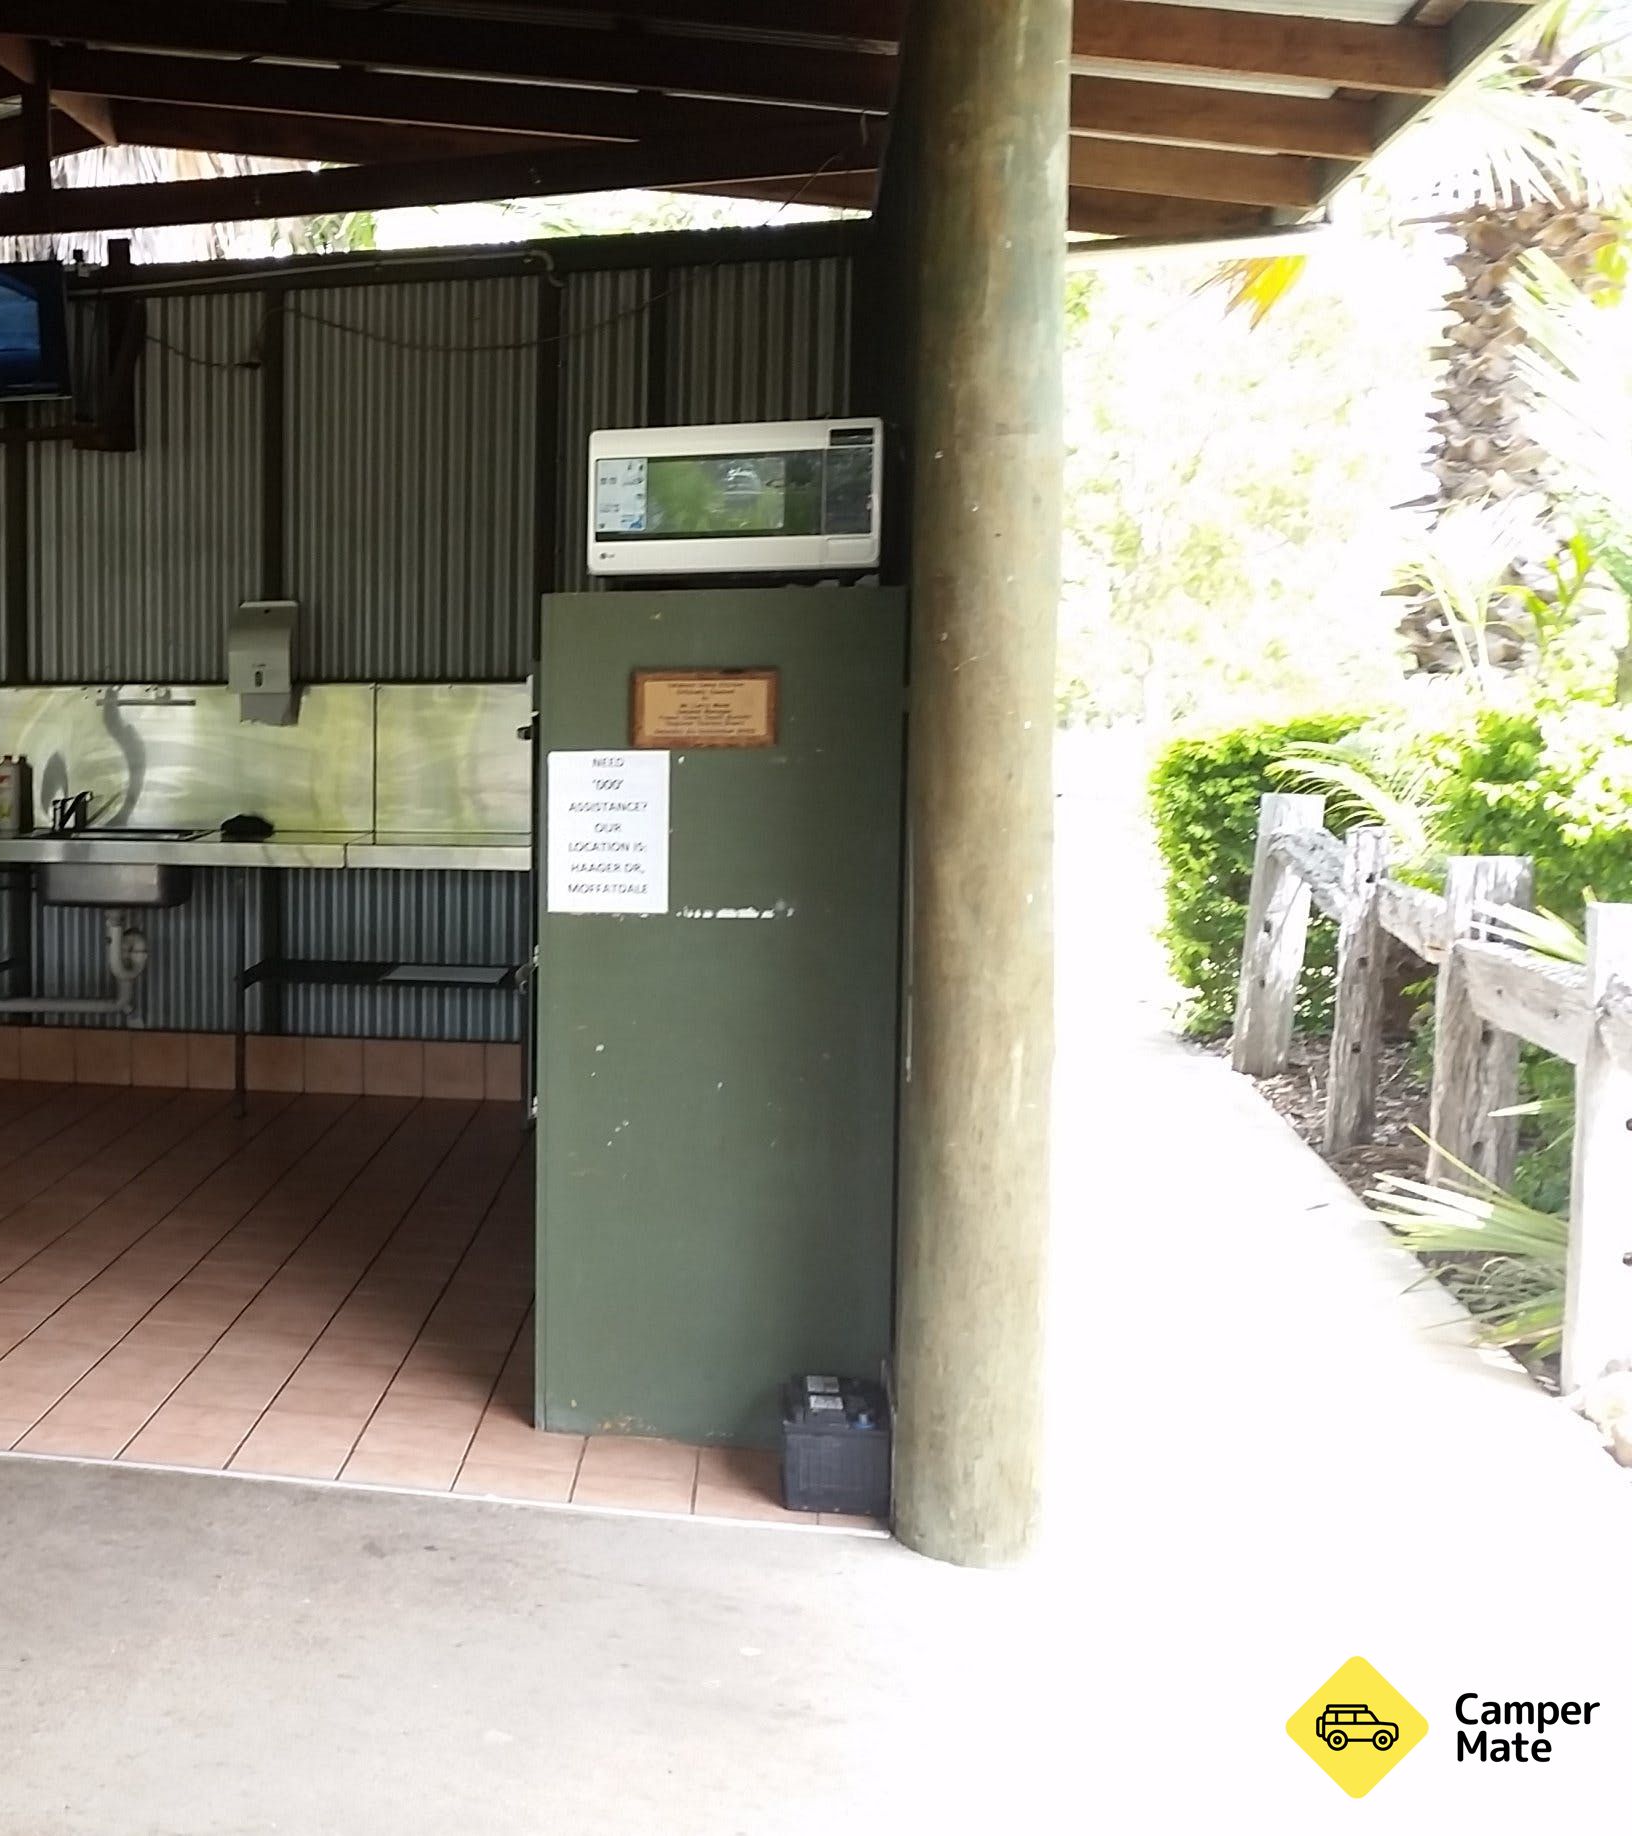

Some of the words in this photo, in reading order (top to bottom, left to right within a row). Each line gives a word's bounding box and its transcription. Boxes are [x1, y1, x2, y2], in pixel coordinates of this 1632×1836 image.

[592, 757, 625, 768] NEED
[568, 801, 648, 812] ASSISTANCE?
[594, 823, 622, 833] OUR
[568, 842, 630, 852] LOCATION
[568, 884, 648, 894] MOFFATDALE
